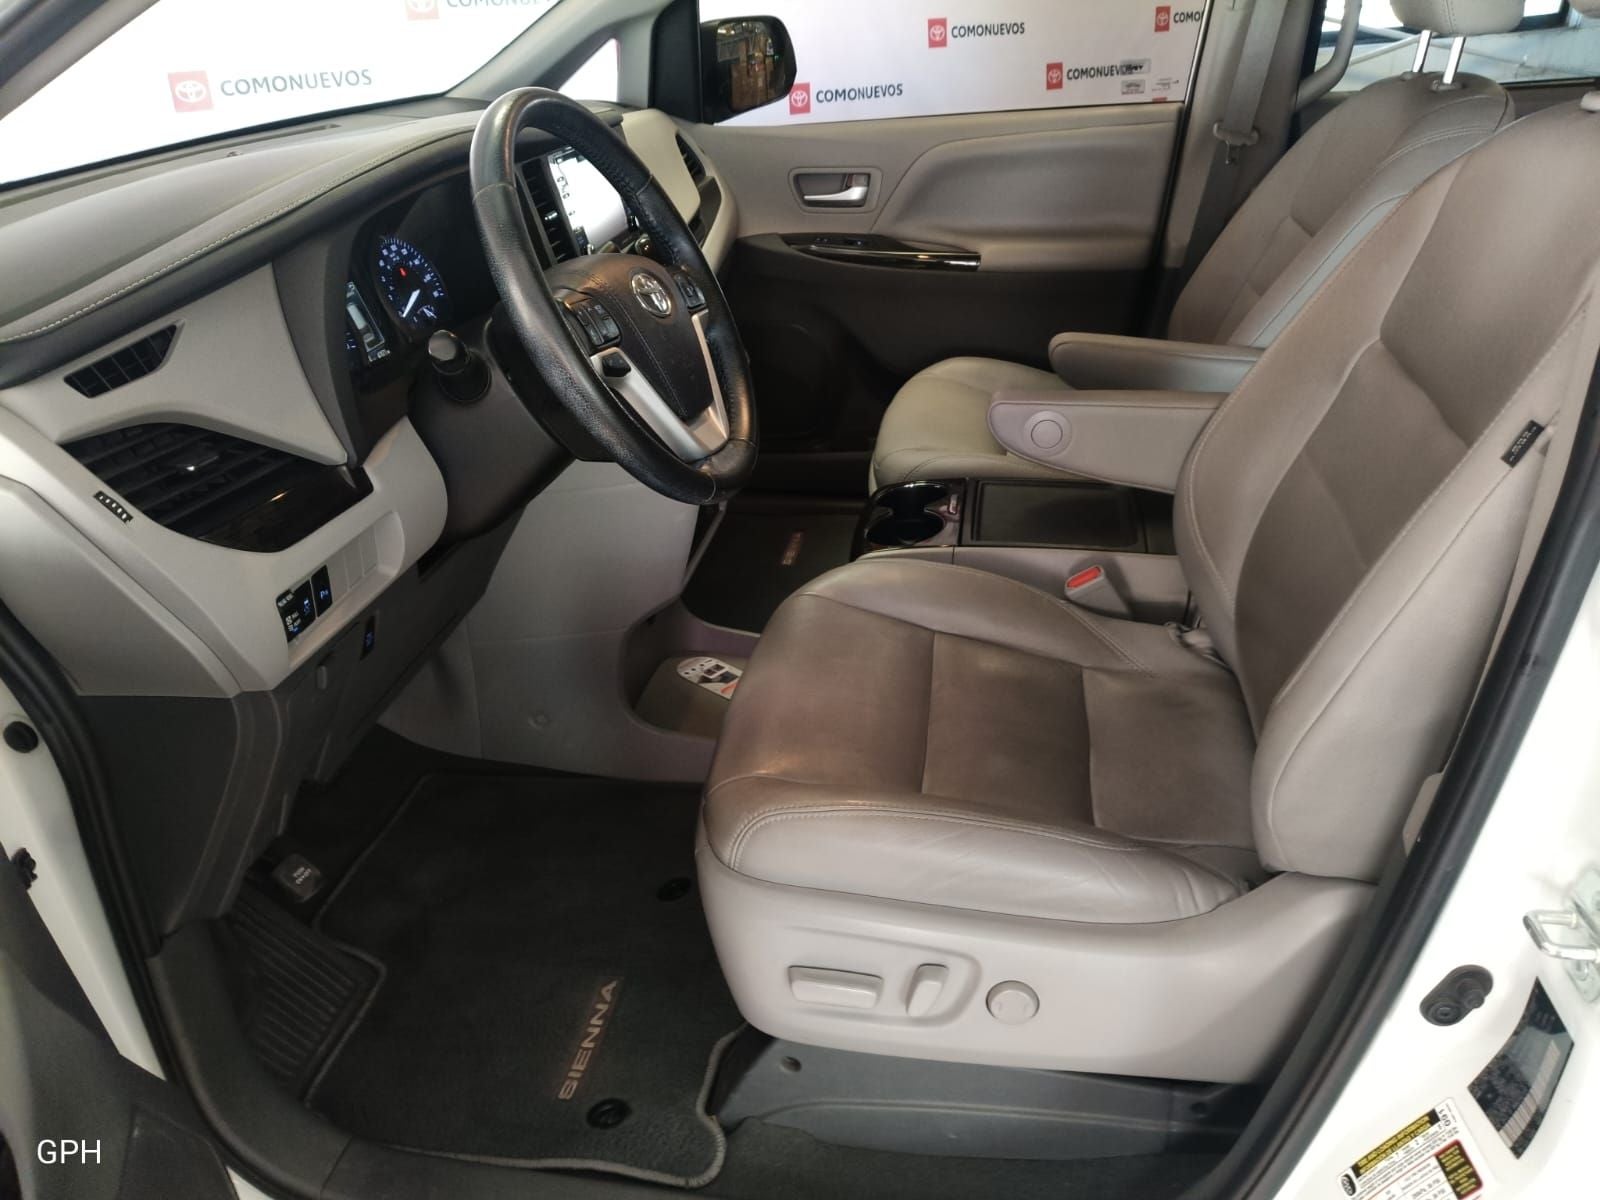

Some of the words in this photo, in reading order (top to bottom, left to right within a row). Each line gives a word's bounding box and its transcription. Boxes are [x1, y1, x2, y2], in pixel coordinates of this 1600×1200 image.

[1173, 11, 1203, 24] COMO
[951, 22, 1025, 38] COMONUEVOS
[220, 69, 372, 96] COMONUEVOS
[816, 83, 903, 103] COMONUEVOS
[558, 980, 618, 1100] SIENNA
